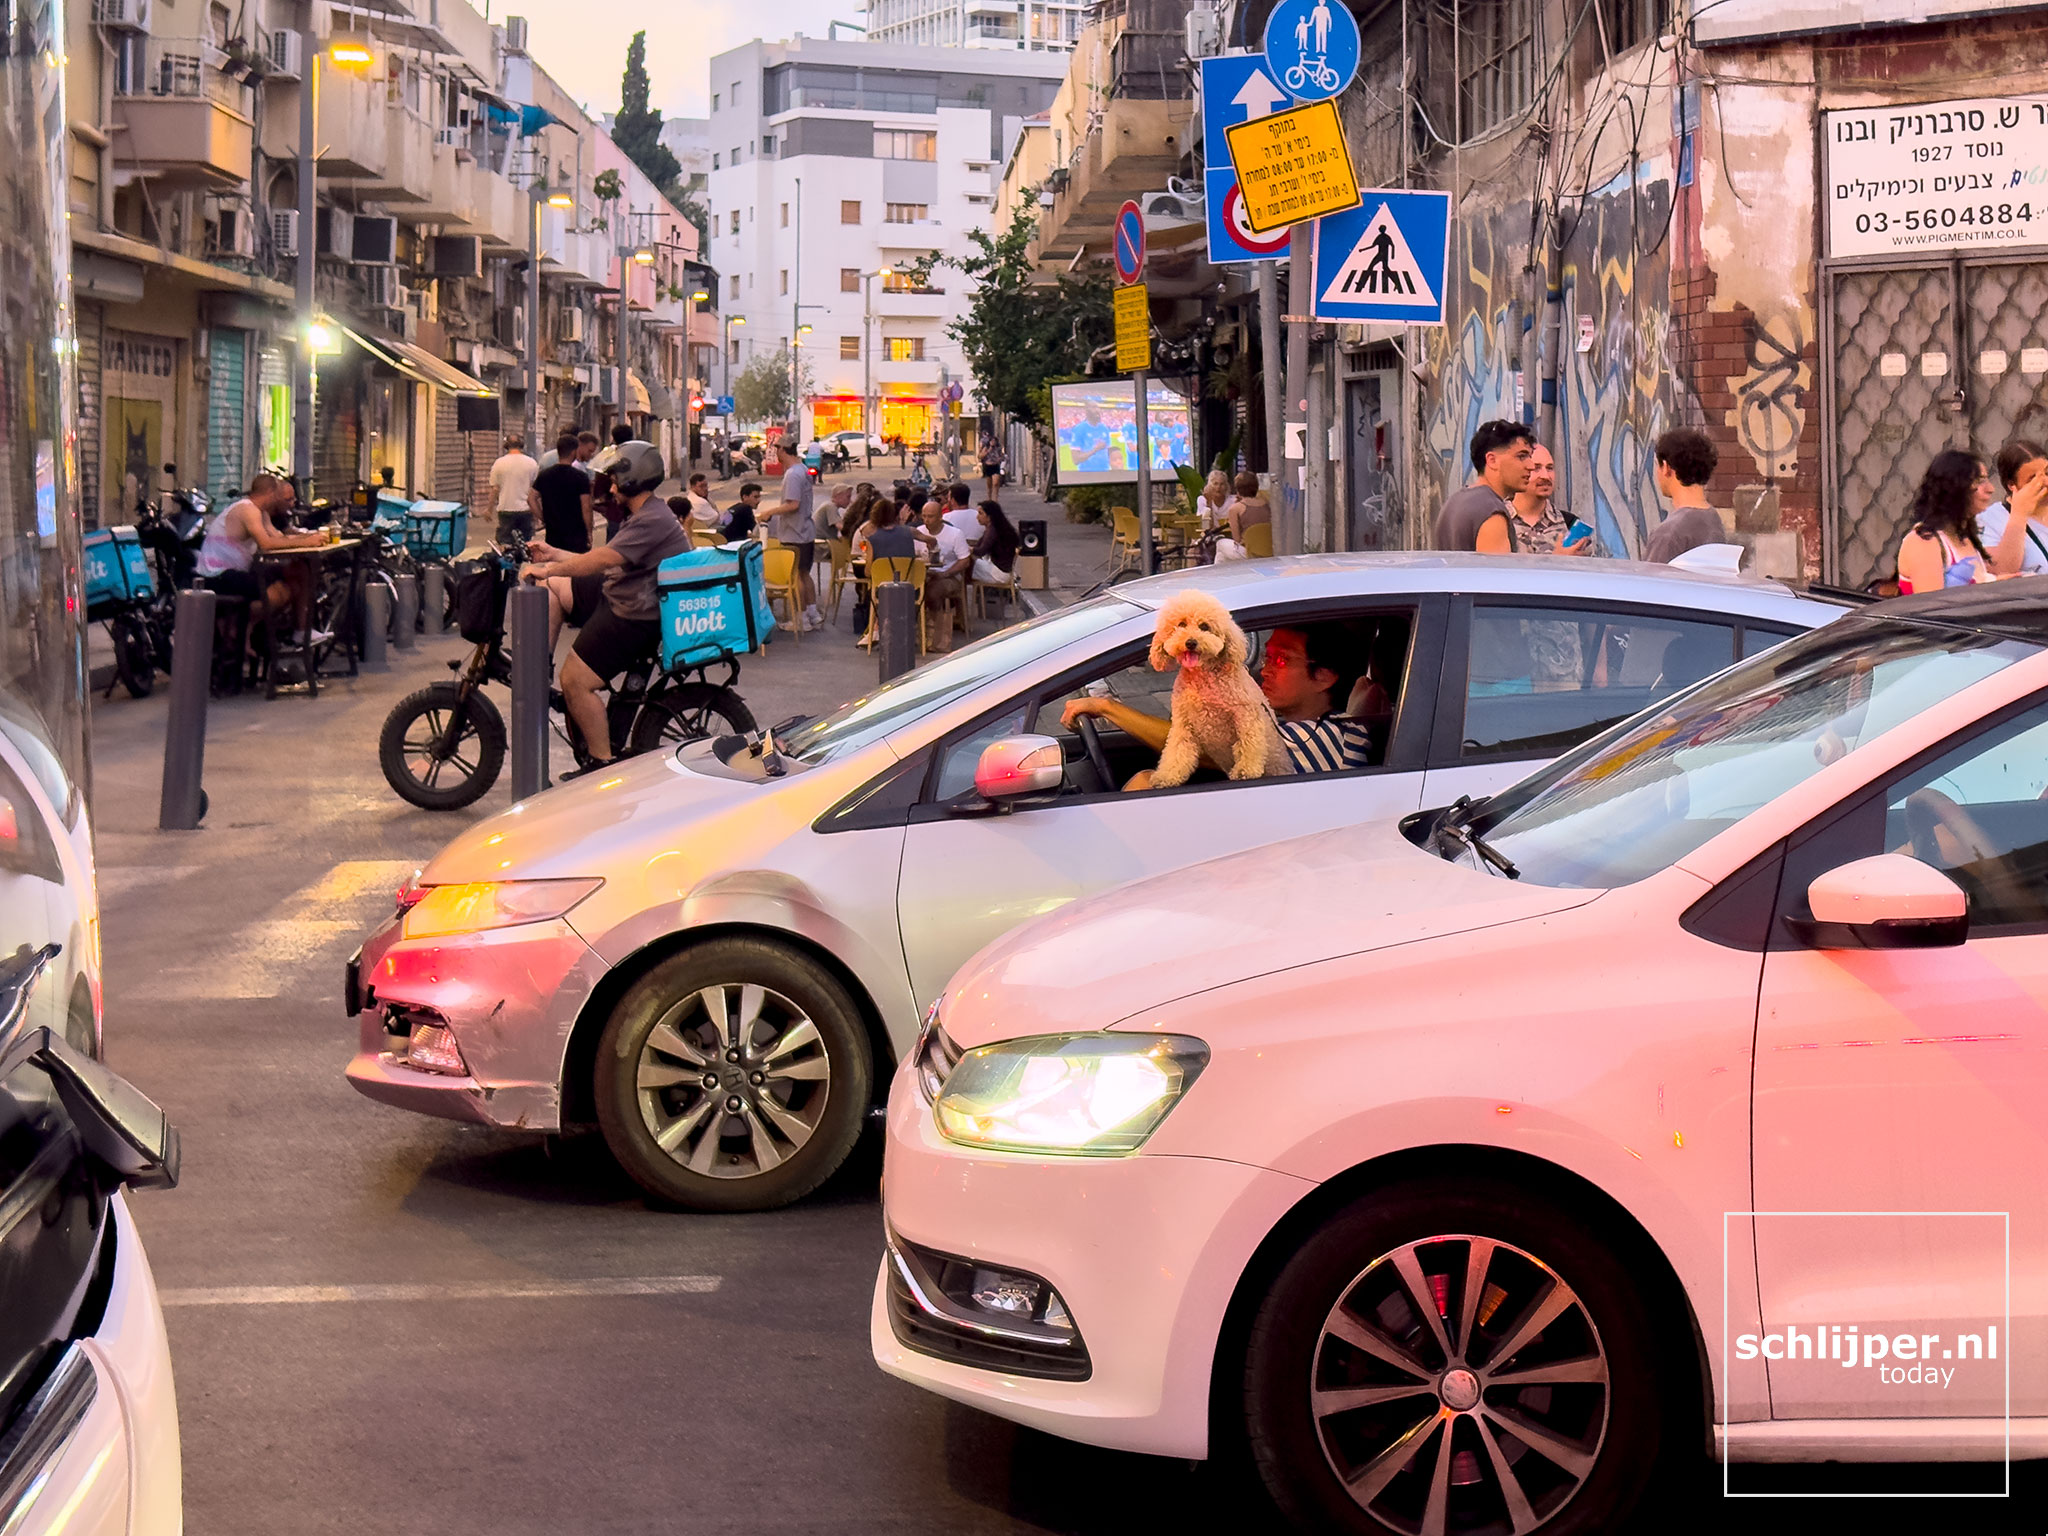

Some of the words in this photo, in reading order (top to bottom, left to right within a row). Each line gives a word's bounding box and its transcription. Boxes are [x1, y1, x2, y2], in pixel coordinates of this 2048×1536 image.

[1994, 106, 2020, 128] ש.
[1268, 119, 1296, 139] בתוקף
[1836, 120, 1876, 142] ובנו
[1890, 109, 1984, 144] סרברניק
[1272, 144, 1282, 156] עד
[1294, 135, 1311, 149] בימי
[1964, 141, 2004, 158] נוסד
[1294, 157, 1304, 169] עד
[1307, 150, 1327, 166] 17:00
[1912, 146, 1952, 162] 1927
[1245, 165, 1270, 185] למחרת
[1272, 160, 1293, 176] 08:00
[1836, 178, 1924, 202] וכימיקלים
[1934, 172, 1993, 192] צבעים
[1856, 202, 2032, 233] 03-5604884
[1892, 230, 2027, 246] WWW.PIGMENTIM.CO.IL
[678, 595, 720, 612] 563815
[675, 611, 726, 636] Wolt
